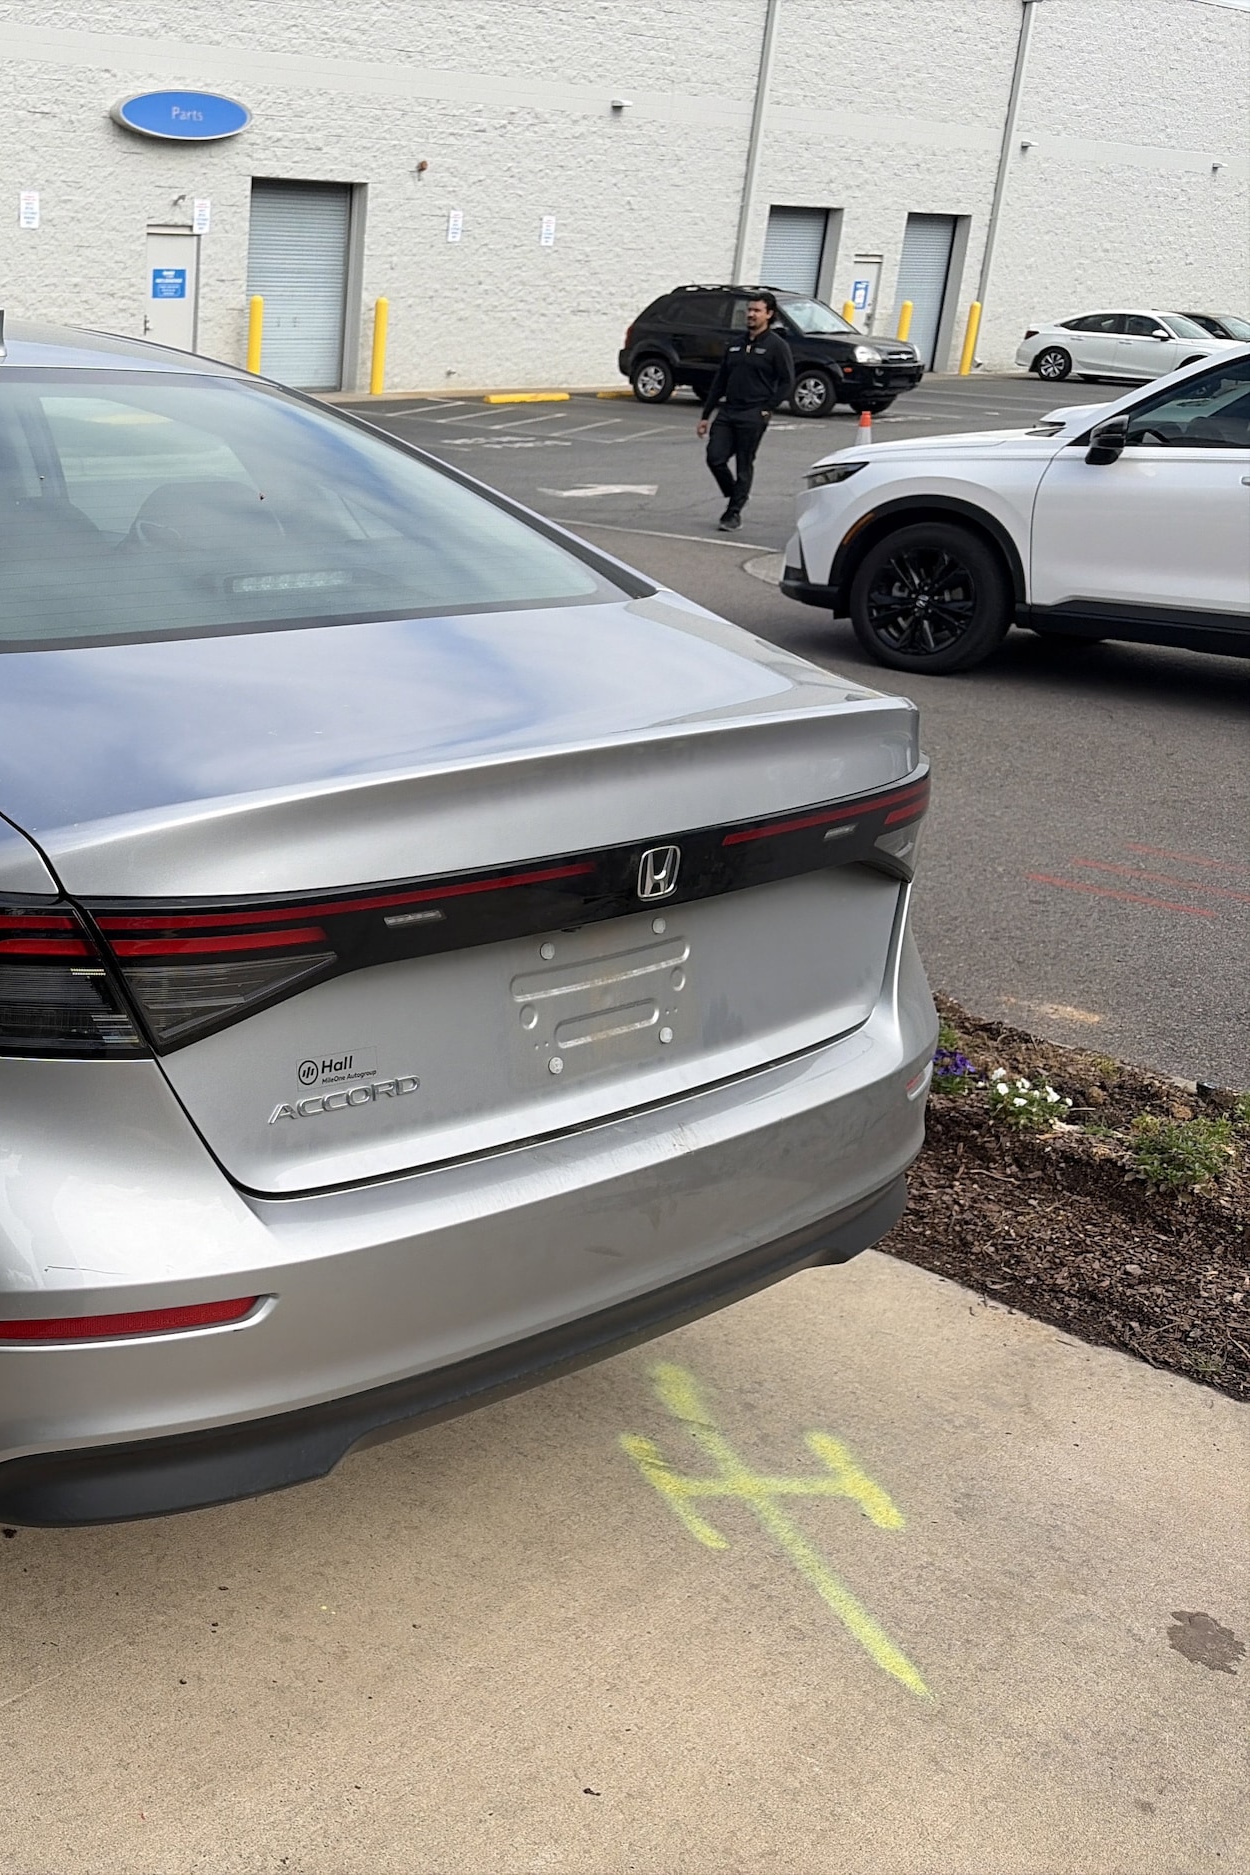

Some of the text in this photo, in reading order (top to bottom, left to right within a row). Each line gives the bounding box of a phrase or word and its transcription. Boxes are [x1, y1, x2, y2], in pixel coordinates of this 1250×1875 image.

[171, 106, 203, 121] Parts
[321, 1055, 353, 1074] Hall
[321, 1070, 377, 1085] MileOne Autogroup
[267, 1074, 421, 1125] ACCORD
